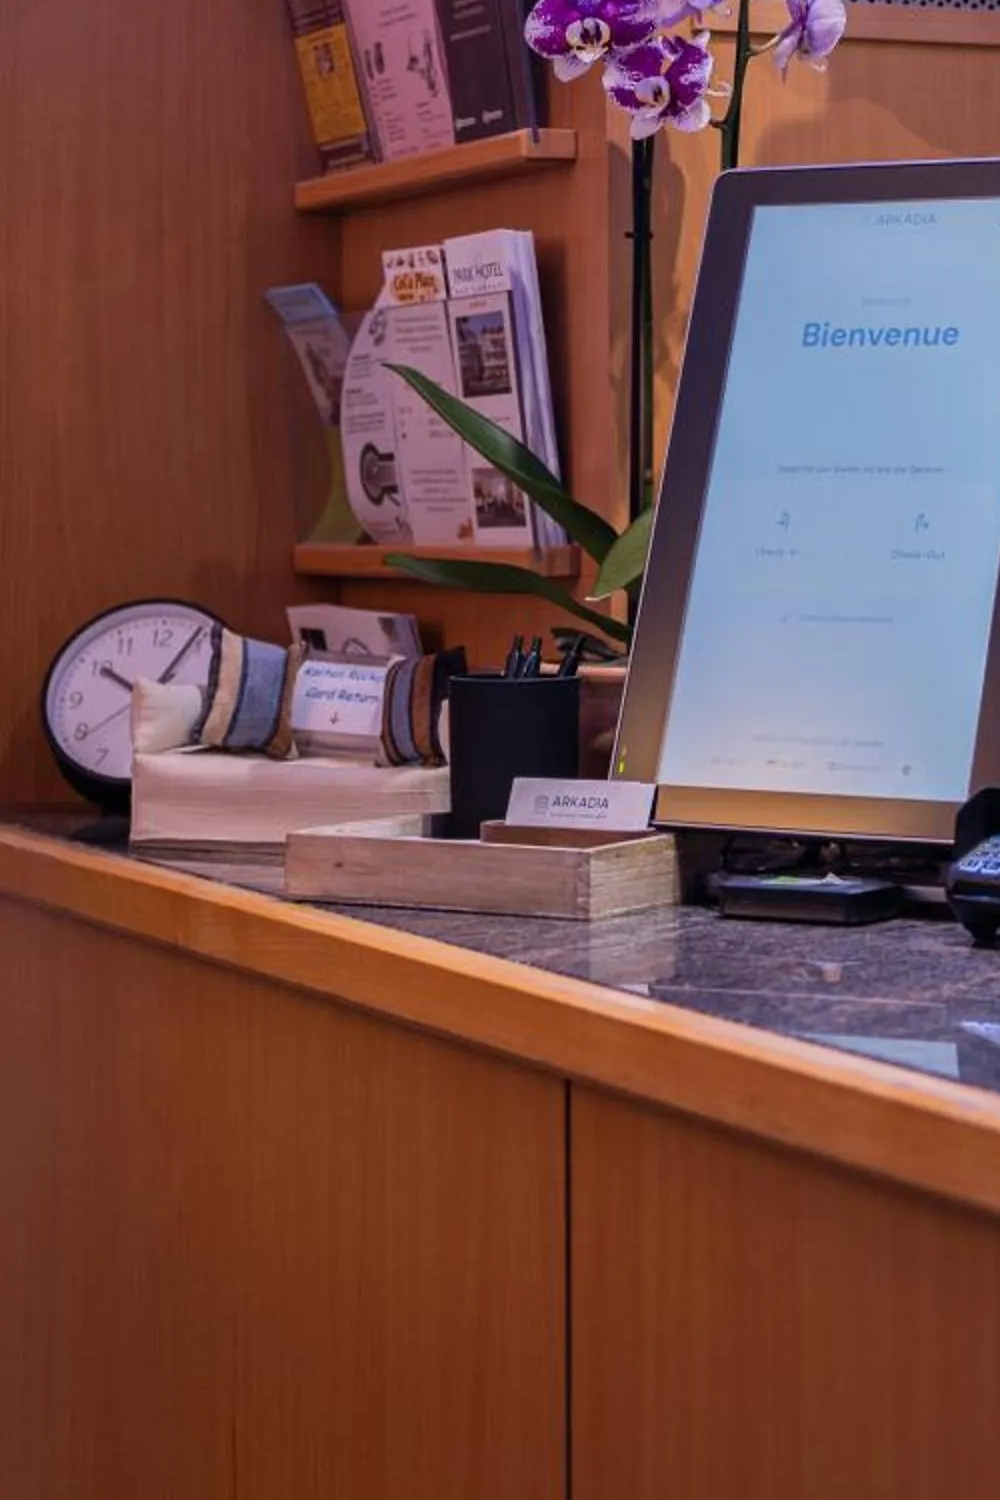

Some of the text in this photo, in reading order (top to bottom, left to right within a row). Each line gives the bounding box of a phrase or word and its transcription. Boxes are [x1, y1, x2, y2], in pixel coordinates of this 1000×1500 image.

[475, 262, 504, 280] HOTEL
[802, 321, 960, 348] Bienvenue
[117, 637, 134, 655] 11
[152, 629, 174, 648] 12
[69, 691, 84, 709] 9
[74, 722, 90, 741] 8
[95, 748, 109, 766] 7
[551, 795, 609, 809] ARKADIA
